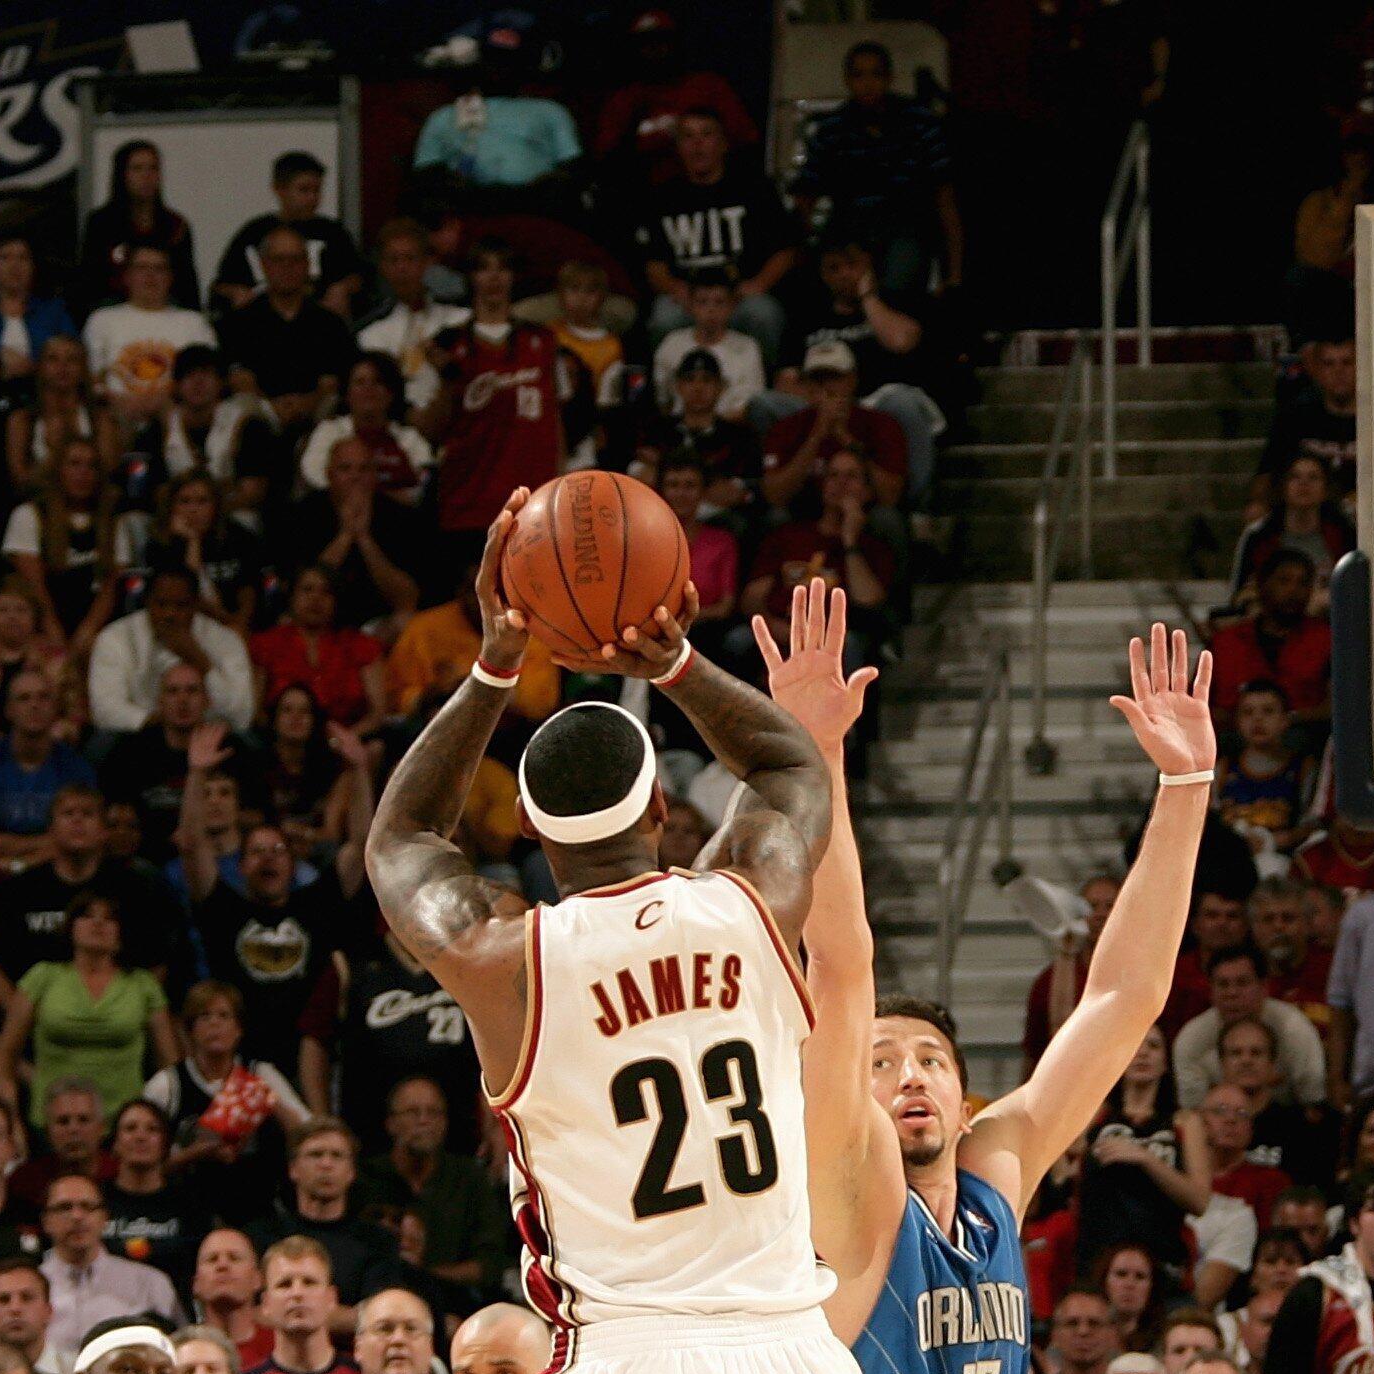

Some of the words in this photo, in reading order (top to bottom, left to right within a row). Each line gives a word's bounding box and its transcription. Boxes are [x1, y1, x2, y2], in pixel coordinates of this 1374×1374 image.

[661, 205, 748, 257] WIT
[592, 951, 743, 1038] JAMES
[609, 1038, 780, 1224] 23
